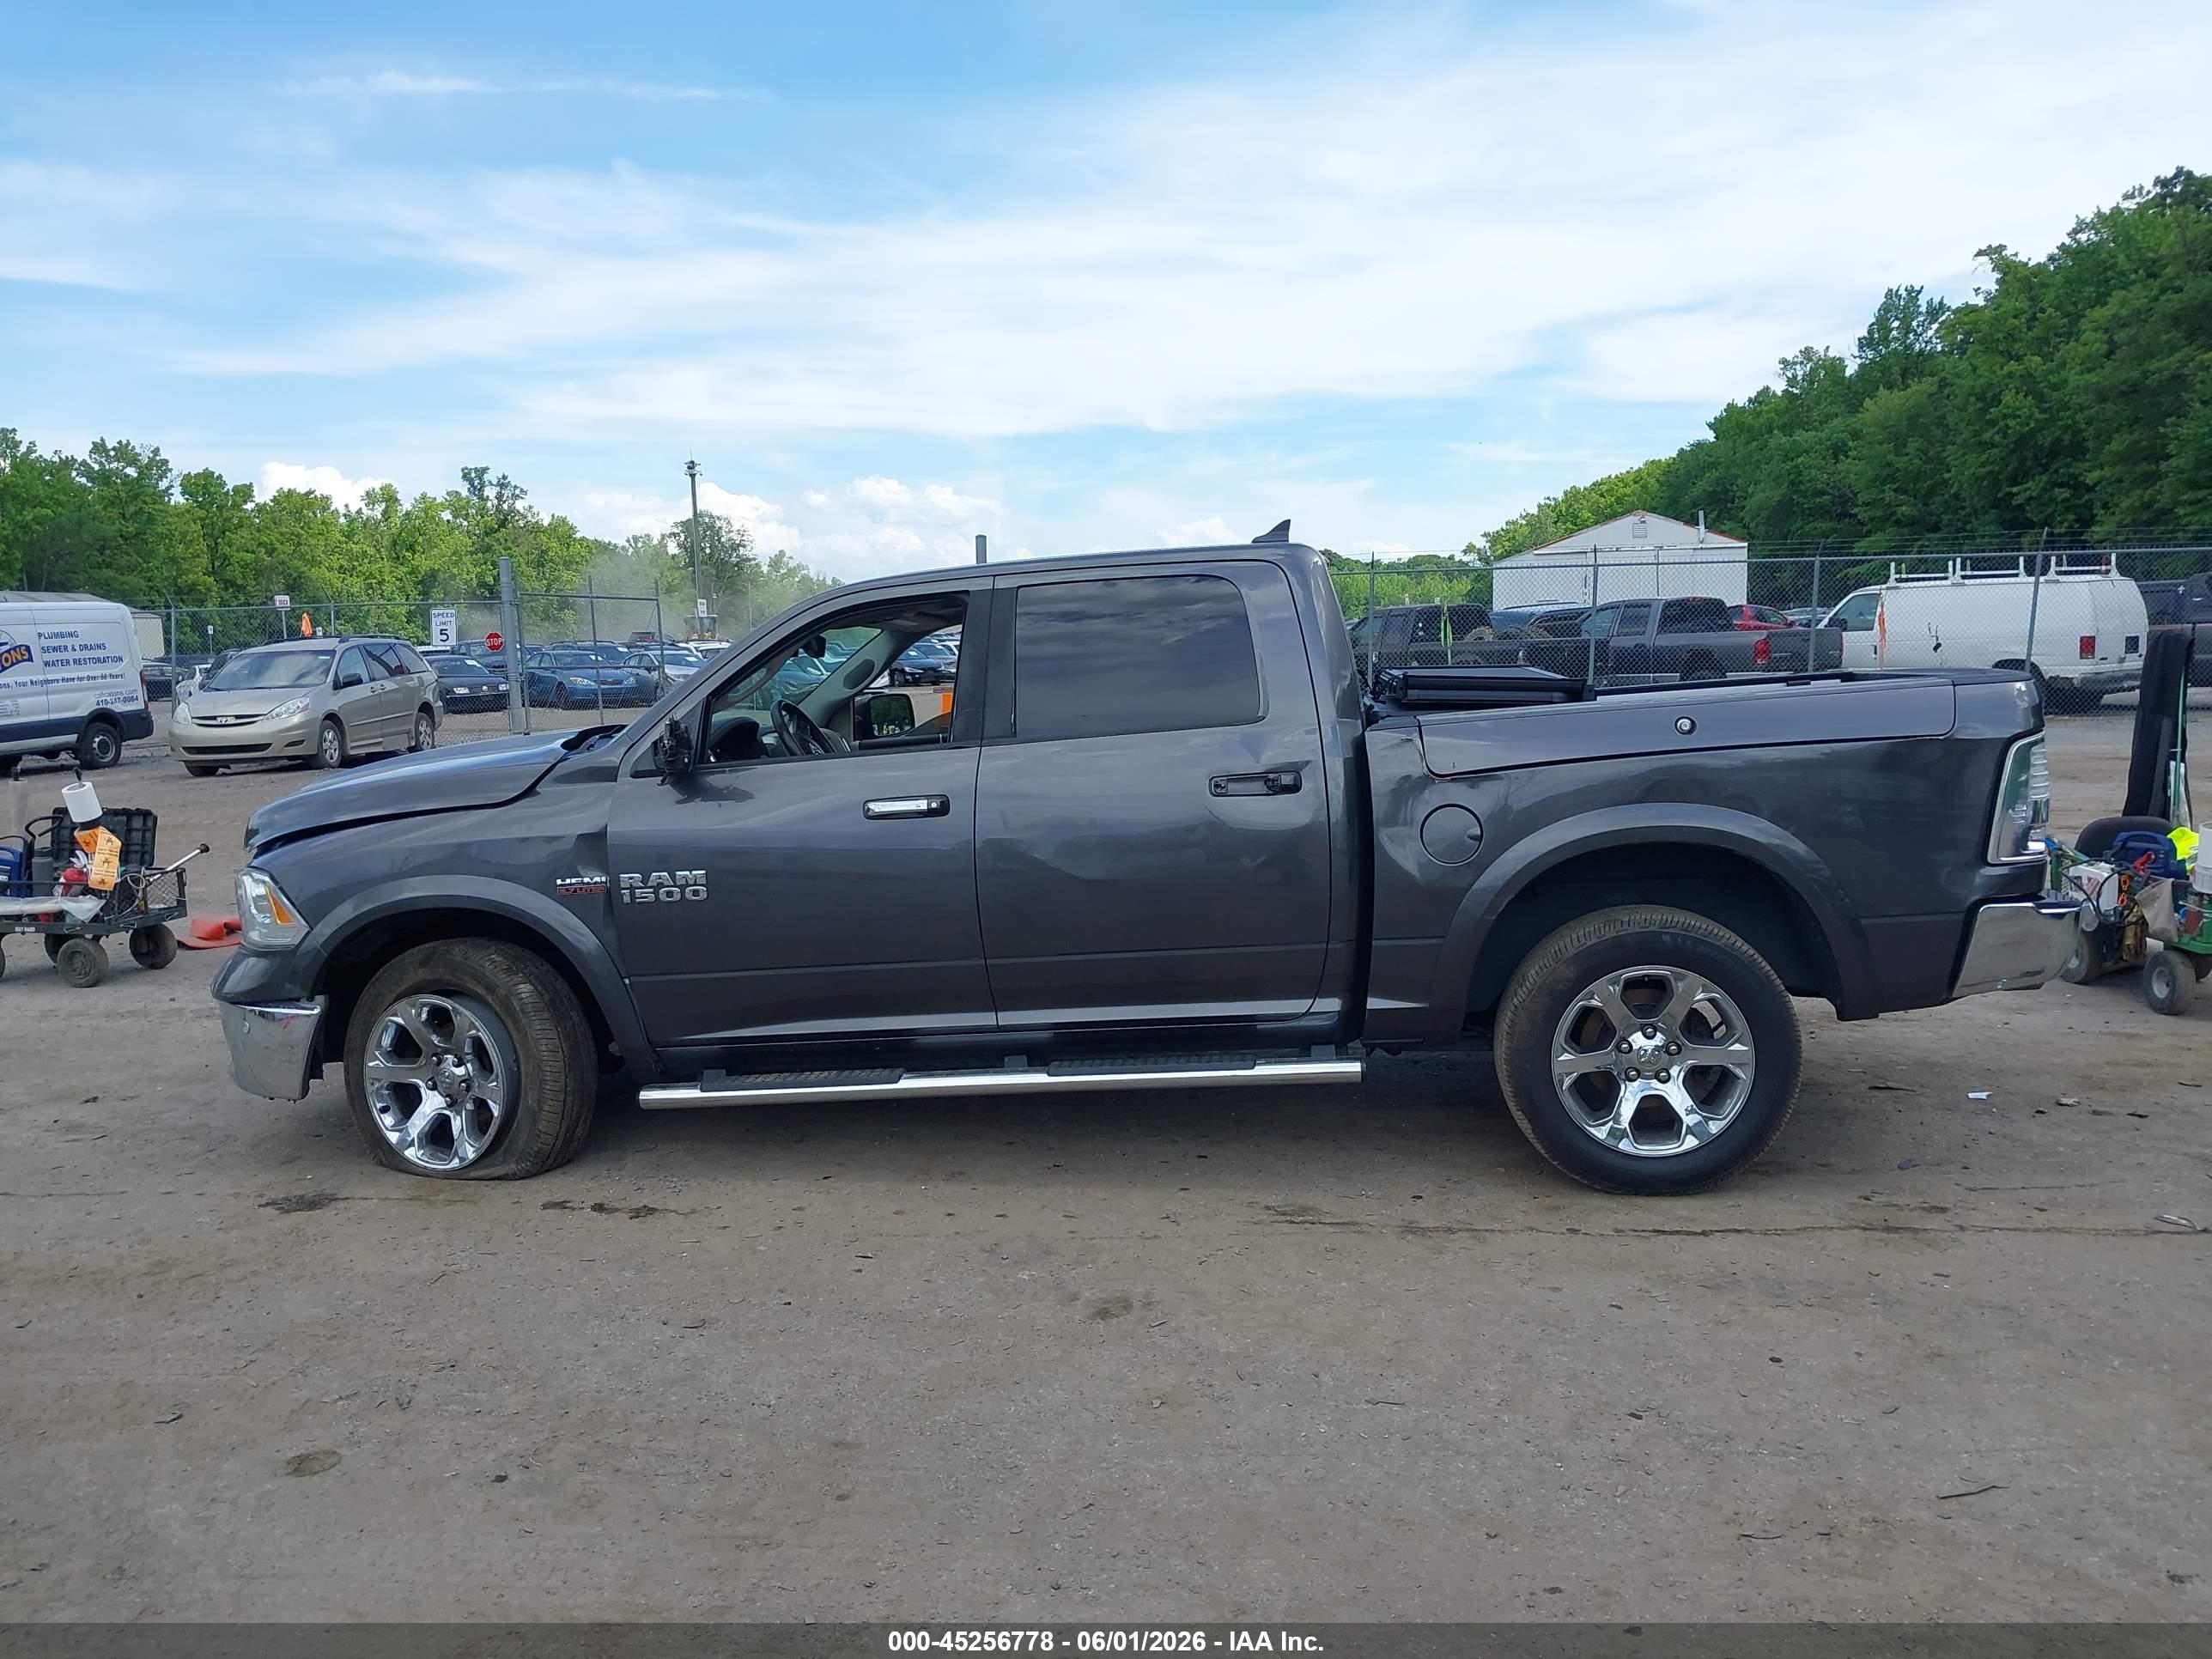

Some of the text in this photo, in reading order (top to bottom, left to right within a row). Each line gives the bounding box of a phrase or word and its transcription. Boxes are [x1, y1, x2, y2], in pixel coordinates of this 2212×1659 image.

[38, 630, 79, 641] PLUMBING
[440, 629, 449, 642] 5
[41, 642, 107, 653] SEWER & DRAINS
[0, 646, 28, 667] ONS
[43, 655, 124, 668] WATER RESTORATION
[30, 678, 59, 687] Neighbors
[556, 877, 606, 885] HEMI
[618, 870, 707, 889] RAM
[621, 885, 708, 904] 1500
